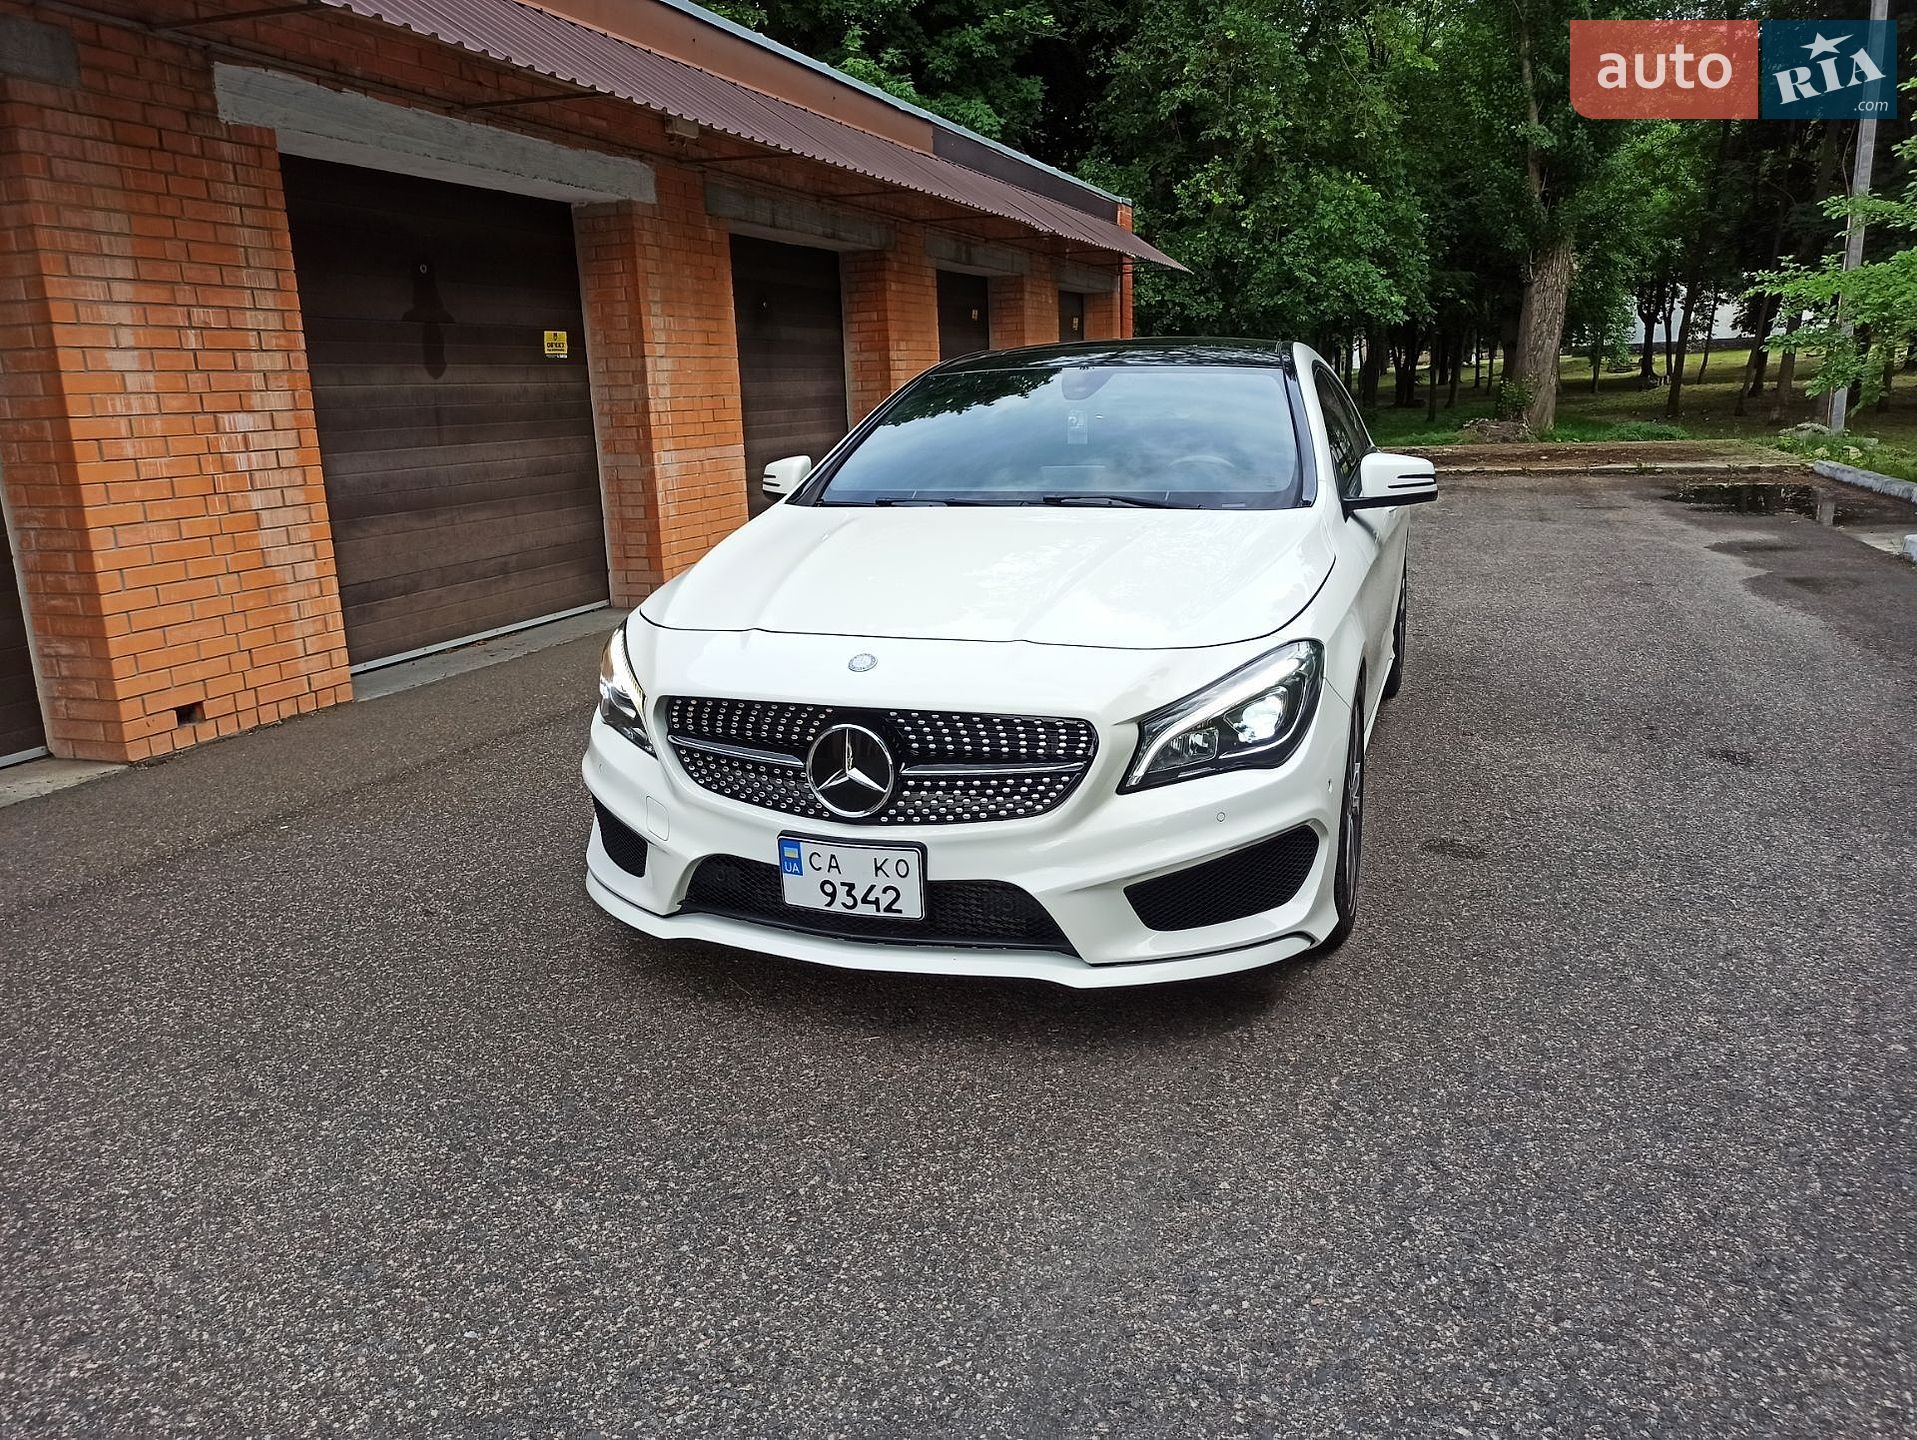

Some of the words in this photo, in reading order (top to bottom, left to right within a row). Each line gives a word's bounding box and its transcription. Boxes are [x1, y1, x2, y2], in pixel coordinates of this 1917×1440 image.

[784, 861, 800, 873] UA
[808, 851, 842, 875] CA
[873, 857, 910, 879] KO
[819, 879, 903, 914] 9342
